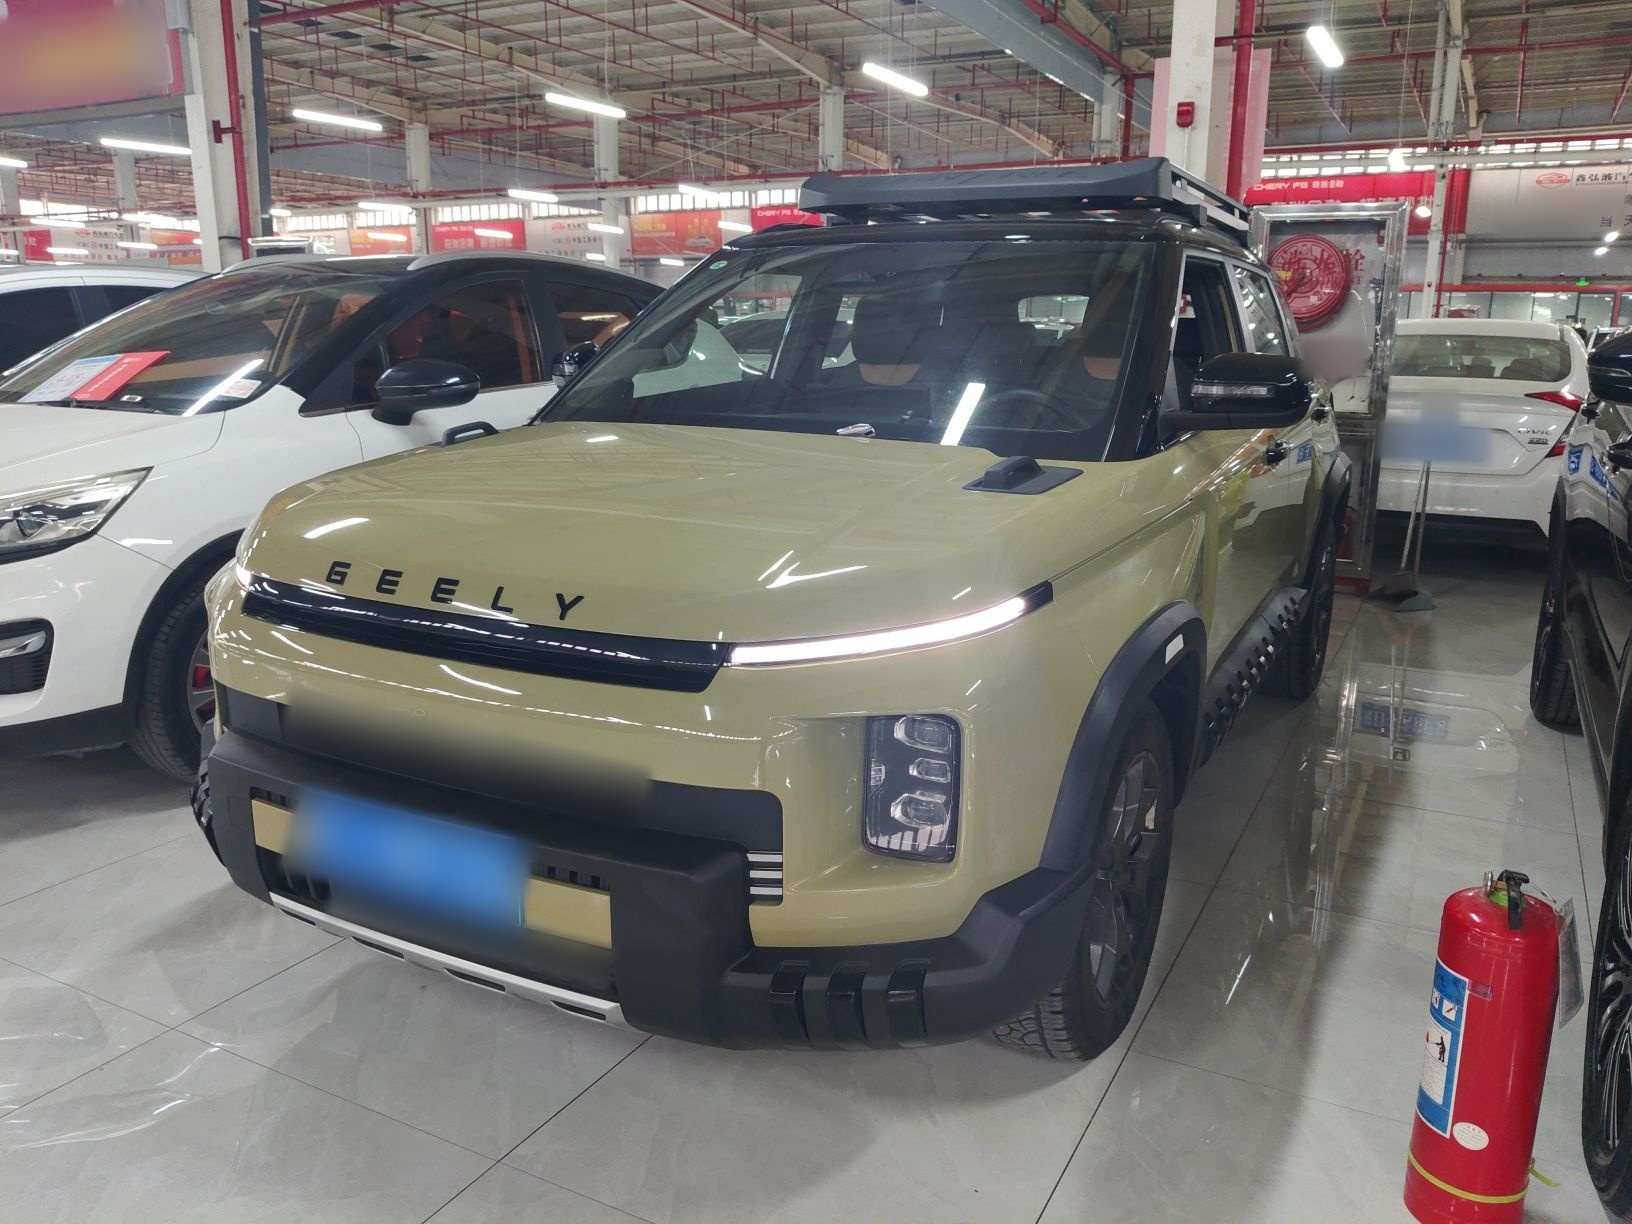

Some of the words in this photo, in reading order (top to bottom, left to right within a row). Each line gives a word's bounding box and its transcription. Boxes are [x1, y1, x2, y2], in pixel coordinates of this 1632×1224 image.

[1253, 182, 1290, 191] CHERY
[1293, 181, 1308, 189] FS
[325, 560, 585, 621] GEELY
